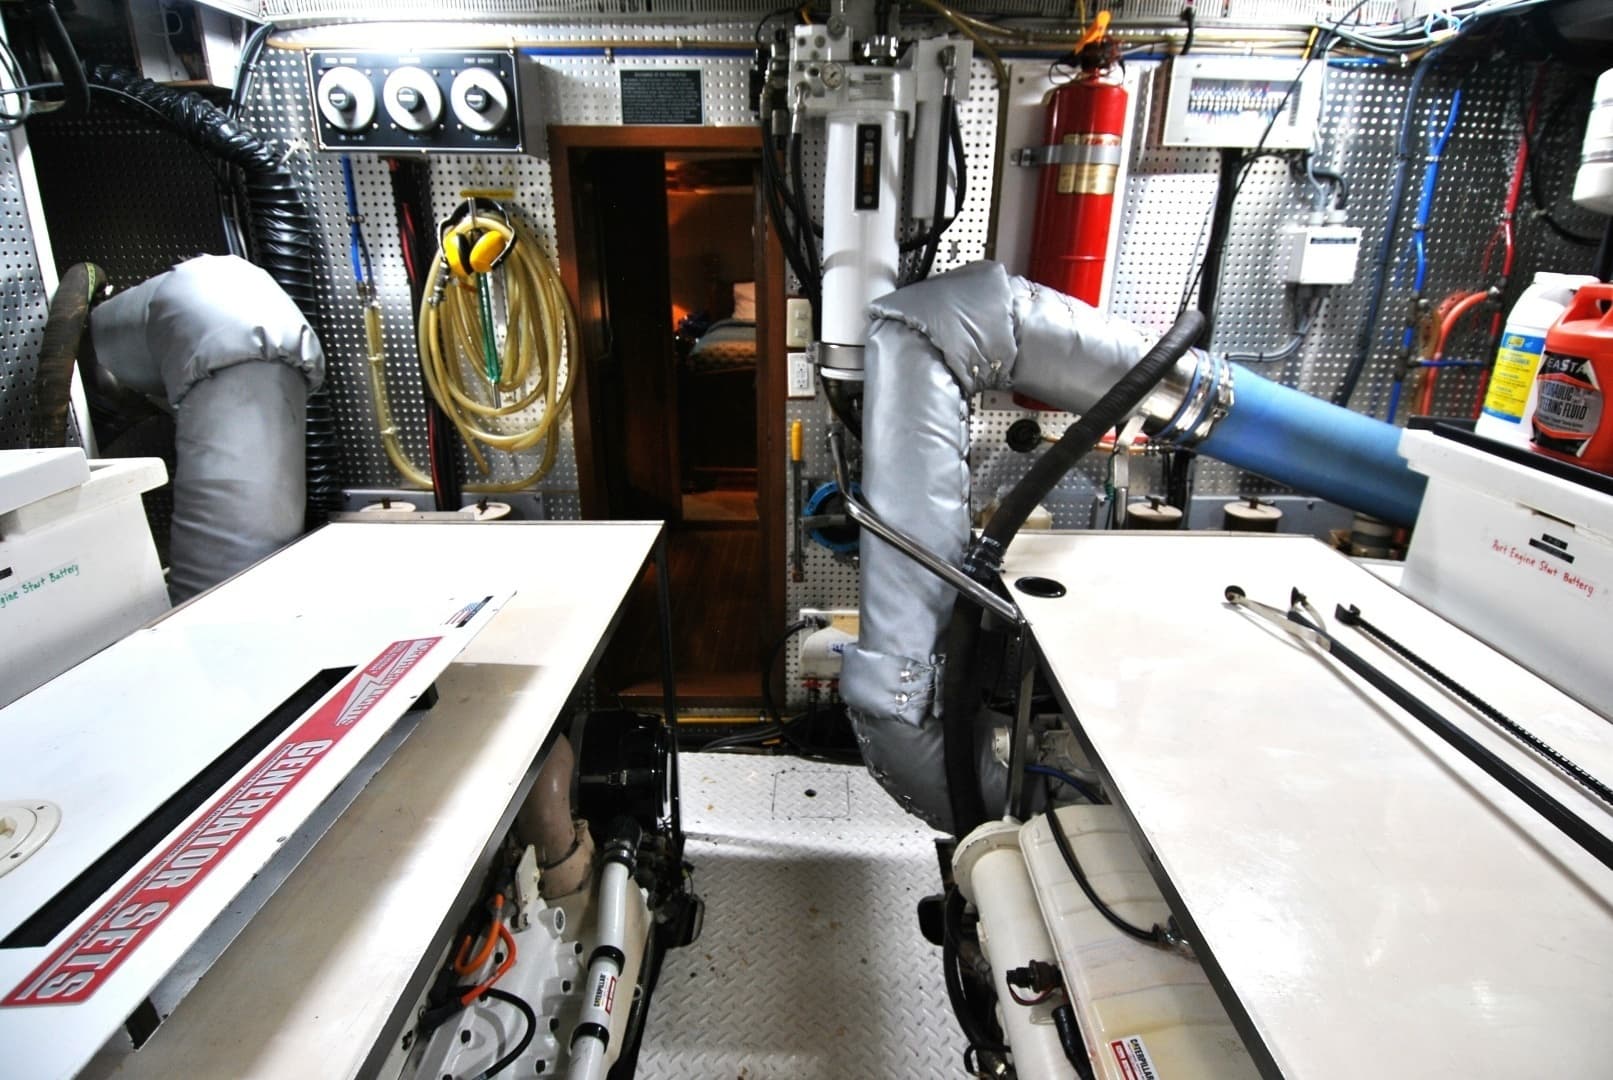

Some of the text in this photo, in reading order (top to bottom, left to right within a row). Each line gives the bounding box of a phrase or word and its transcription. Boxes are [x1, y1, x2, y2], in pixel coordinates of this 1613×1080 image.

[1562, 403, 1588, 420] FLUID
[22, 577, 46, 593] Start
[49, 565, 80, 582] Battery
[1510, 547, 1536, 565] Engine
[1539, 560, 1558, 576] Start
[1563, 572, 1594, 598] Battery
[341, 685, 387, 726] LIGHTS
[35, 739, 334, 998] GENERATOR SETS
[593, 974, 606, 1007] CATERPILLAR
[1130, 1038, 1155, 1080] CATERPILLAR
